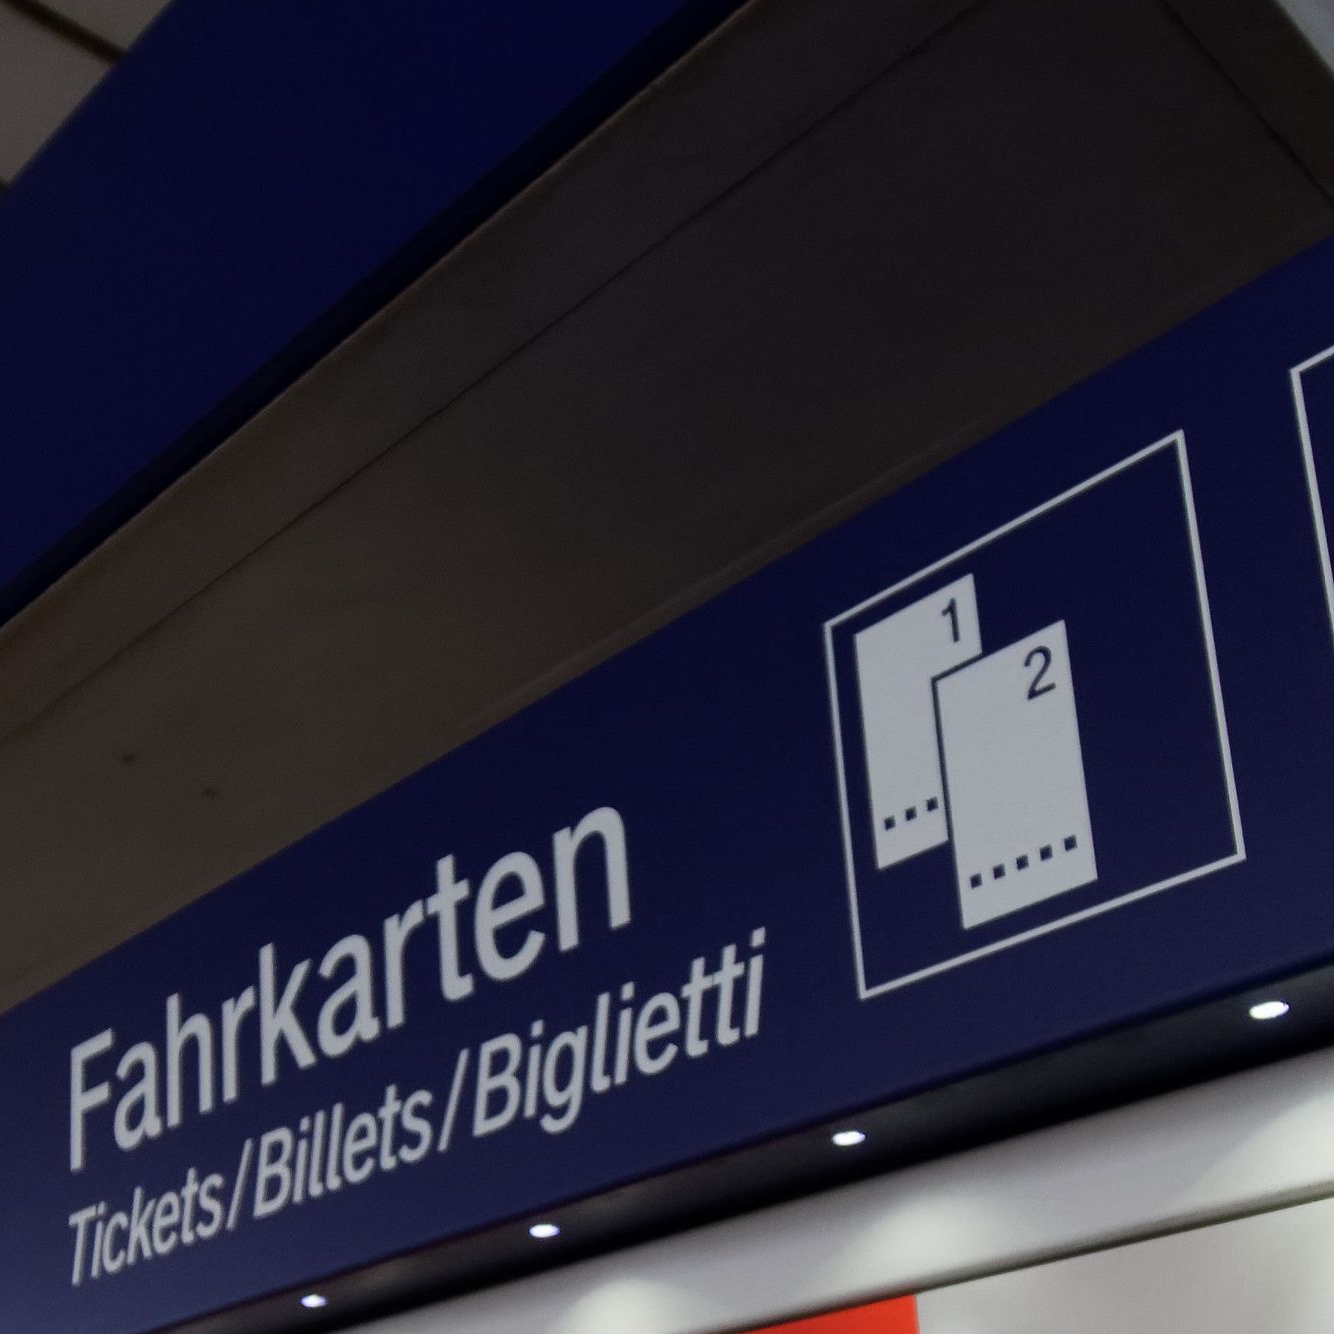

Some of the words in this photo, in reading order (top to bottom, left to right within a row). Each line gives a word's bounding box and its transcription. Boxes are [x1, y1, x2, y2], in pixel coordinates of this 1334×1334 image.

[940, 597, 961, 643] 1
[1022, 645, 1057, 701] 2
[67, 805, 632, 1172] Fahrkarten
